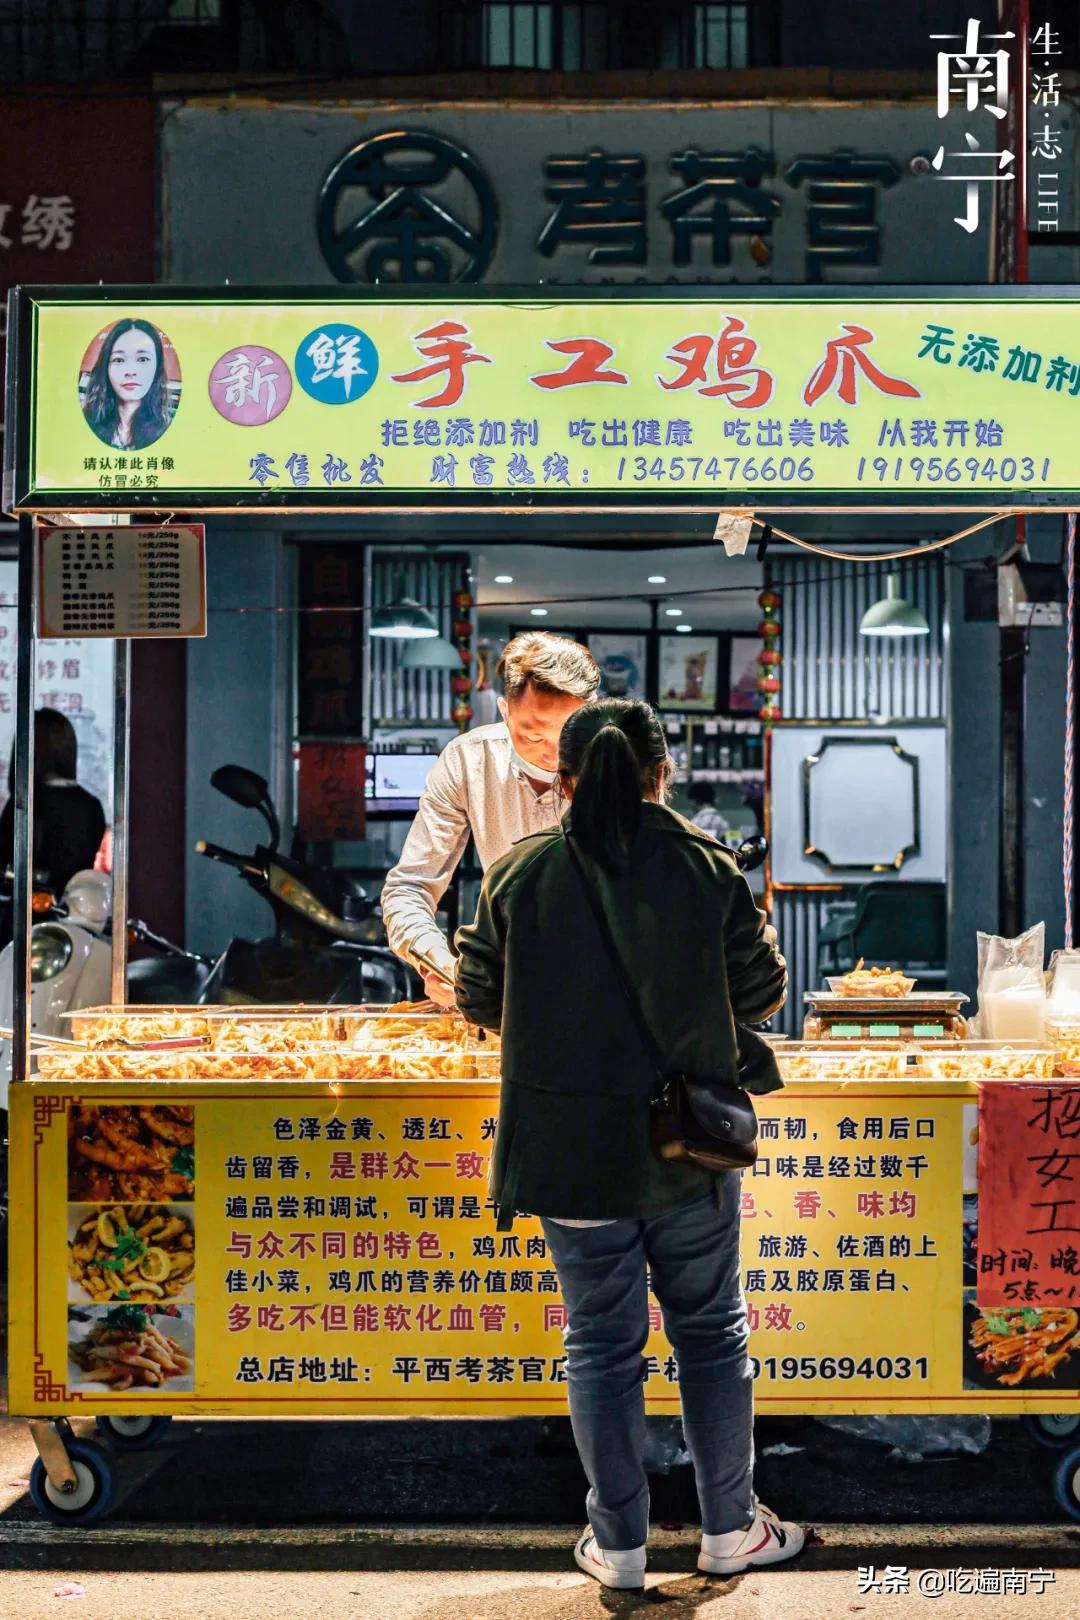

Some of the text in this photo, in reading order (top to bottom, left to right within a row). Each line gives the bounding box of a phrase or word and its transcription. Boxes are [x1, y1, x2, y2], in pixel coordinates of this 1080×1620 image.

[214, 332, 369, 420] 新 鲜
[389, 315, 922, 410] 手工鸡爪
[917, 323, 1080, 396] 无添加剂
[380, 418, 1004, 447] 拒绝添加剂 吃出健康 吃出美味 从我开始
[83, 456, 175, 471] 请认准此肖像
[98, 474, 160, 488] 仿冒必究
[248, 452, 385, 487] 零售批发
[616, 457, 815, 482] 13457476606
[856, 456, 1051, 482] 19195694031
[752, 1155, 930, 1178] 口味是经过数千
[1026, 1088, 1080, 1235] 招女工
